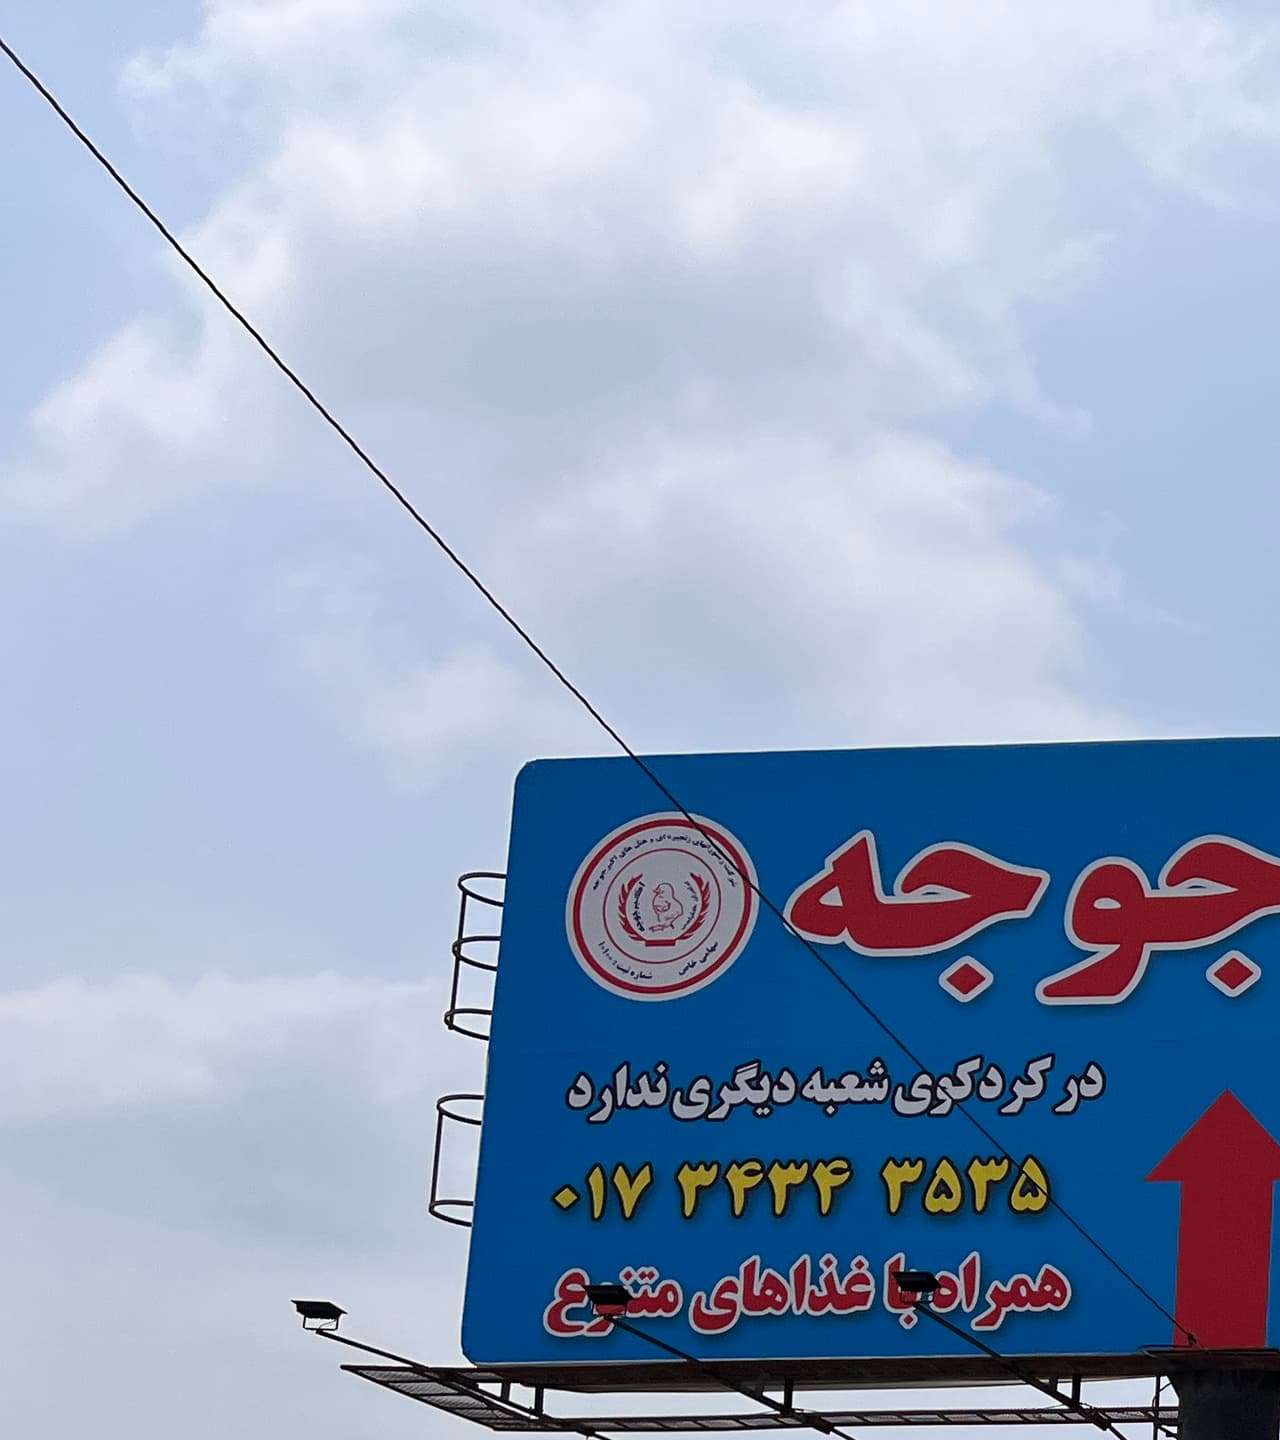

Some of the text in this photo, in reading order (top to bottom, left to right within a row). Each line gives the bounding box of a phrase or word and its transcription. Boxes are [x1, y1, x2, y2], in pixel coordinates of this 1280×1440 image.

[566, 1054, 1105, 1123] در کردکوی شعبه دیگری ندارد
[553, 1156, 1050, 1220] ۰۱۷ ۳۴۳۴ ۳۵۳۵
[688, 1252, 877, 1336] غذاهای
